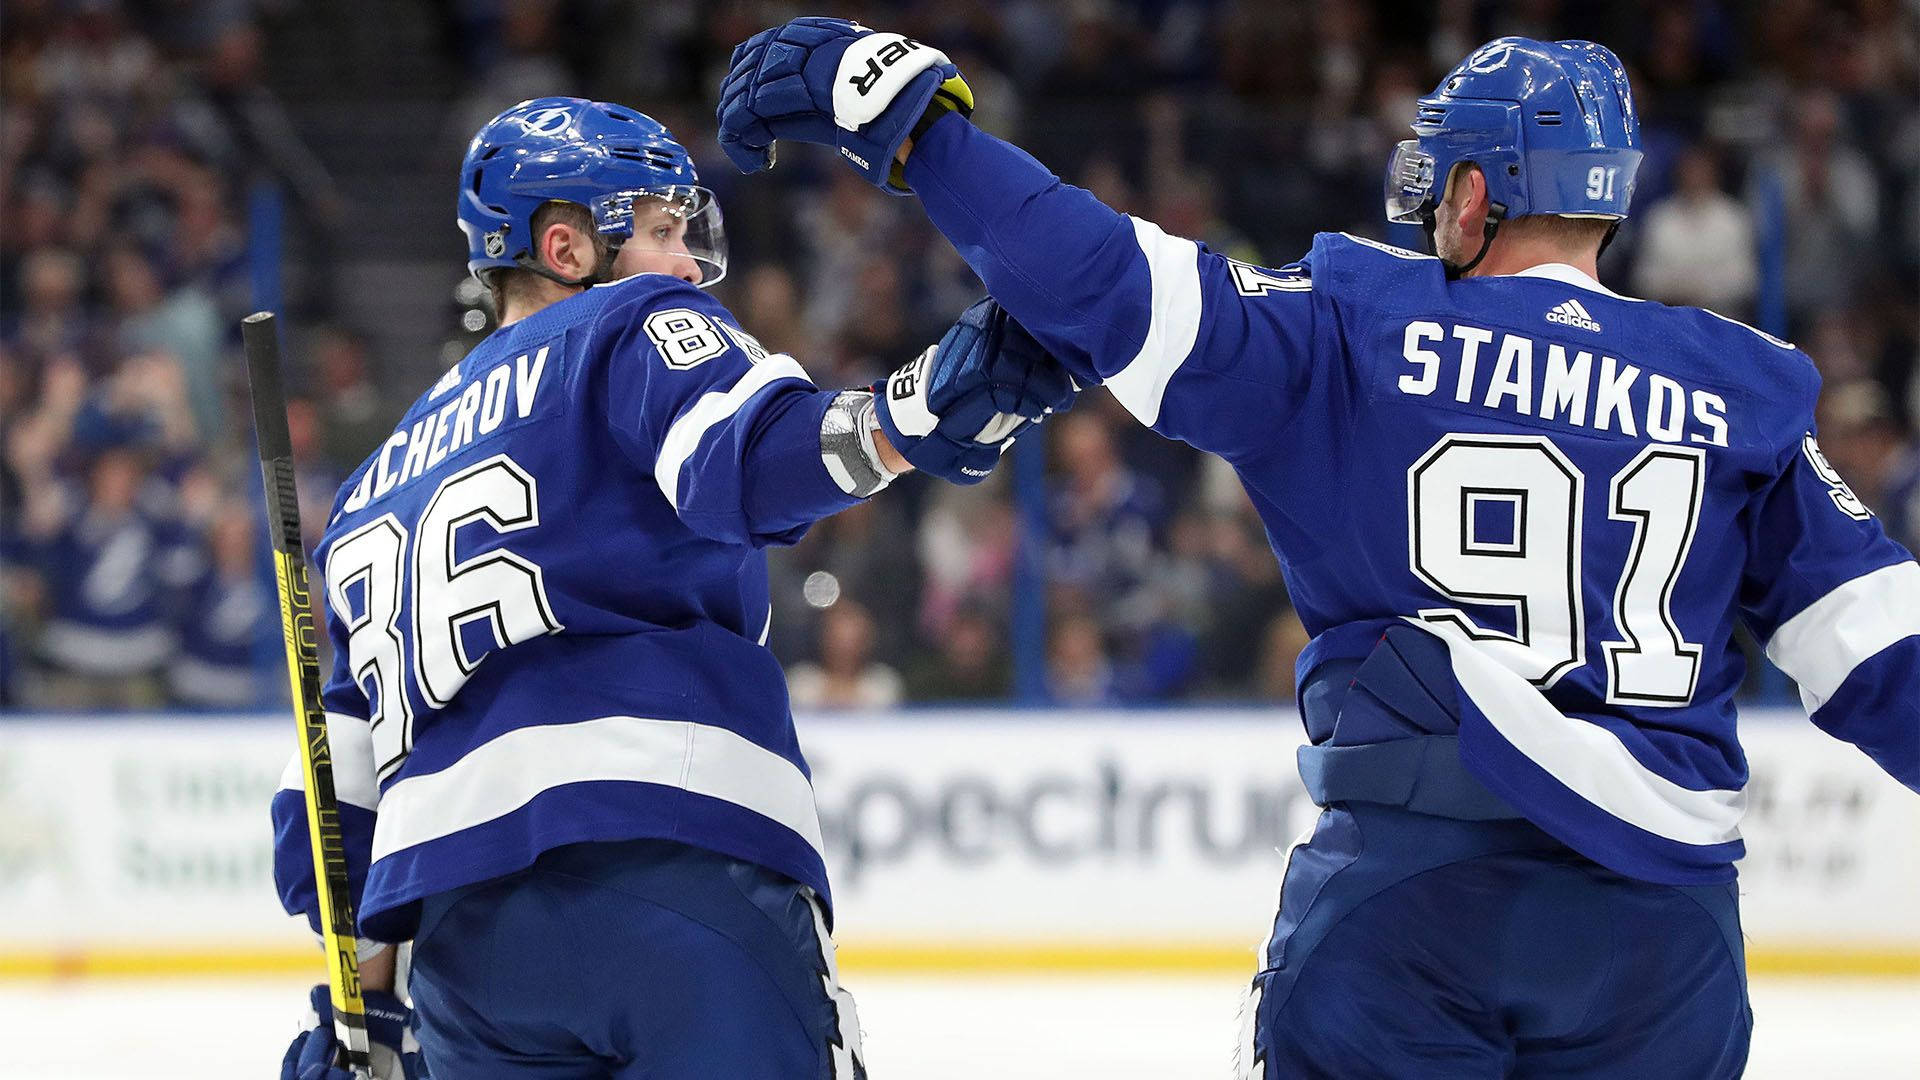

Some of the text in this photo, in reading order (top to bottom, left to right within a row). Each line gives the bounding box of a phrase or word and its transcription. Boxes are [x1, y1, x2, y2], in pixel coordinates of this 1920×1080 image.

[1586, 166, 1620, 201] 91
[1398, 320, 1729, 447] STAMKOS
[1545, 311, 1601, 333] adidas
[332, 345, 550, 524] UCHEROV
[326, 453, 566, 789] 86
[1407, 432, 1707, 708] 91
